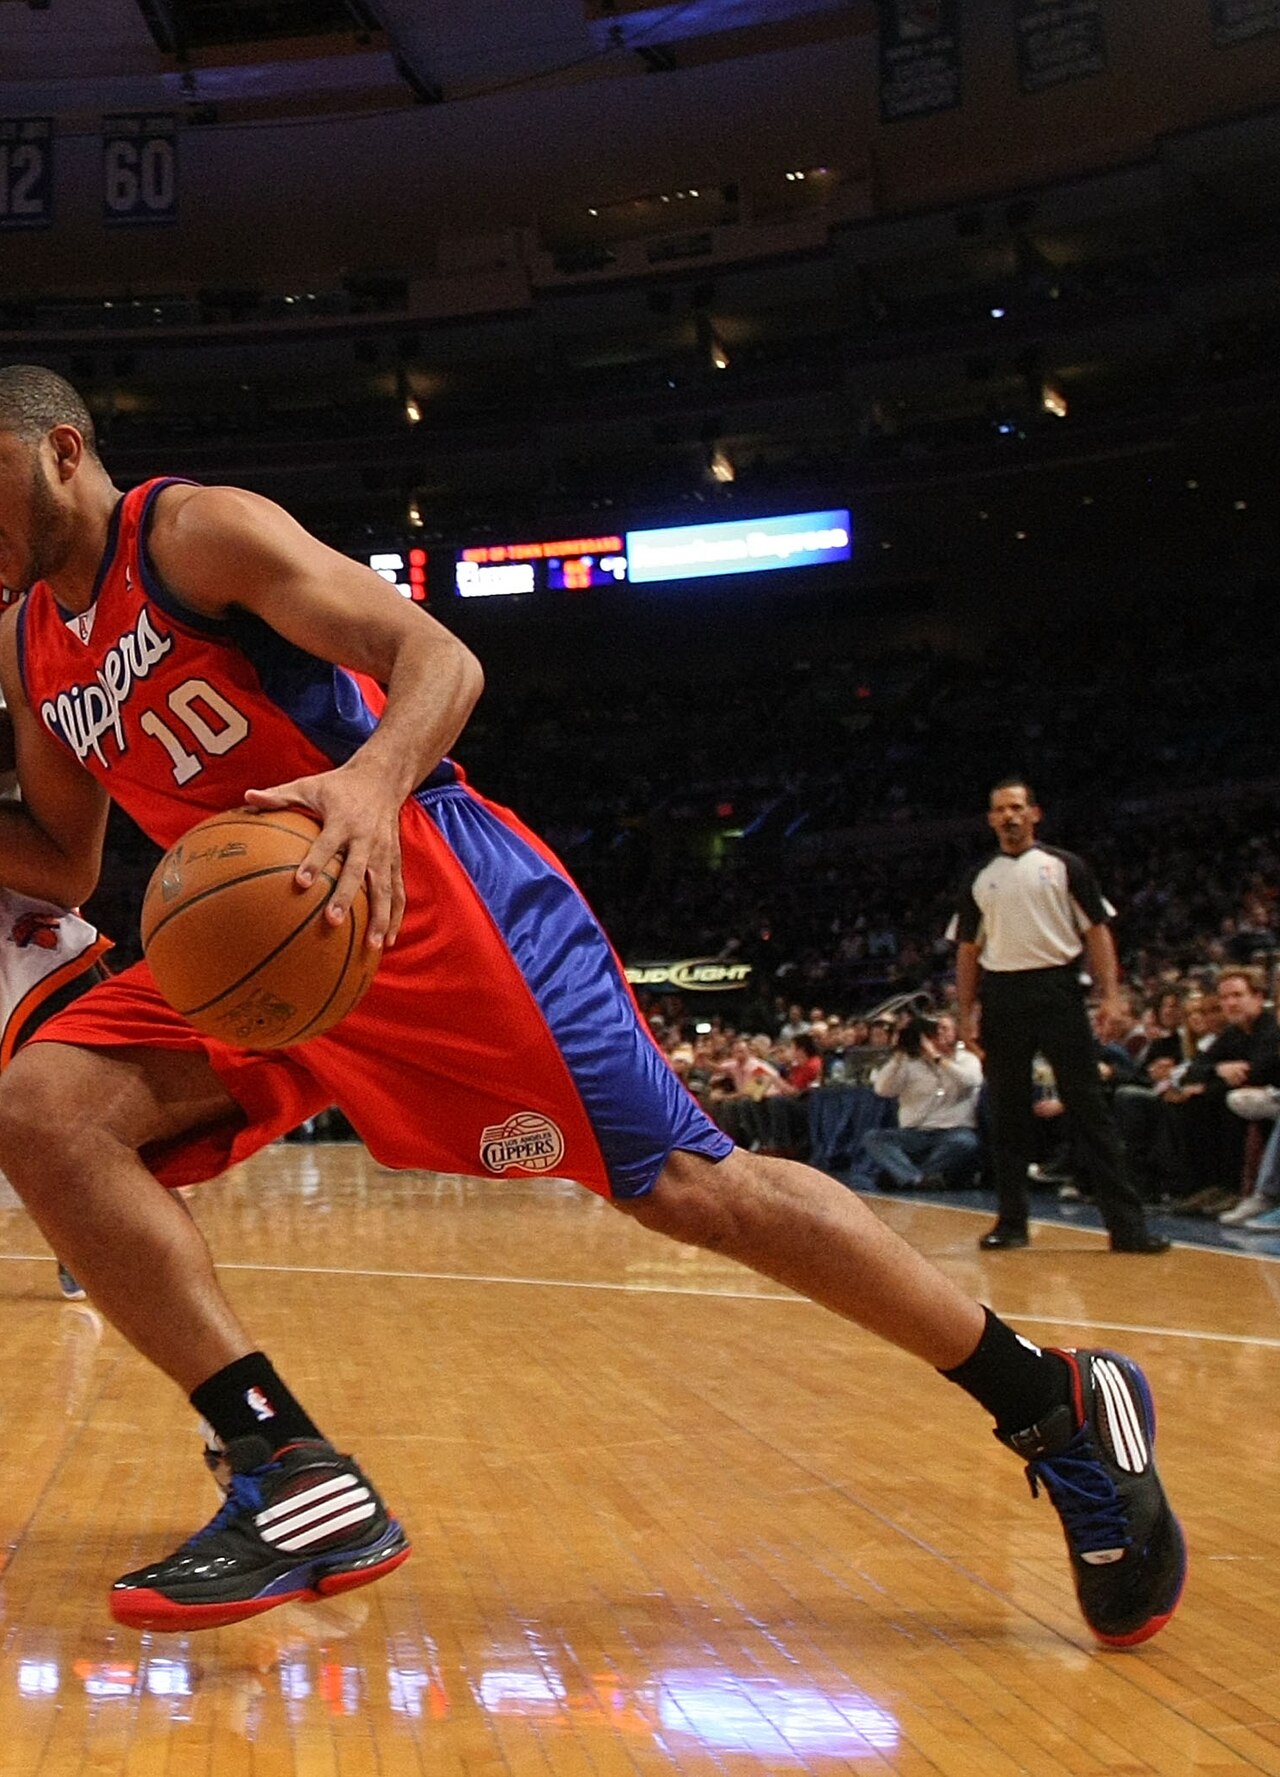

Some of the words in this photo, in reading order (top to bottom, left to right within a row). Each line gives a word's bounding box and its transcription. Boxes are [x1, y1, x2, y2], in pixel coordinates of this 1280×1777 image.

[107, 138, 175, 211] 60
[41, 606, 171, 769] Clippers
[140, 678, 249, 786] 10
[679, 964, 752, 982] LIGHT
[482, 1138, 555, 1171] CLIPPERS
